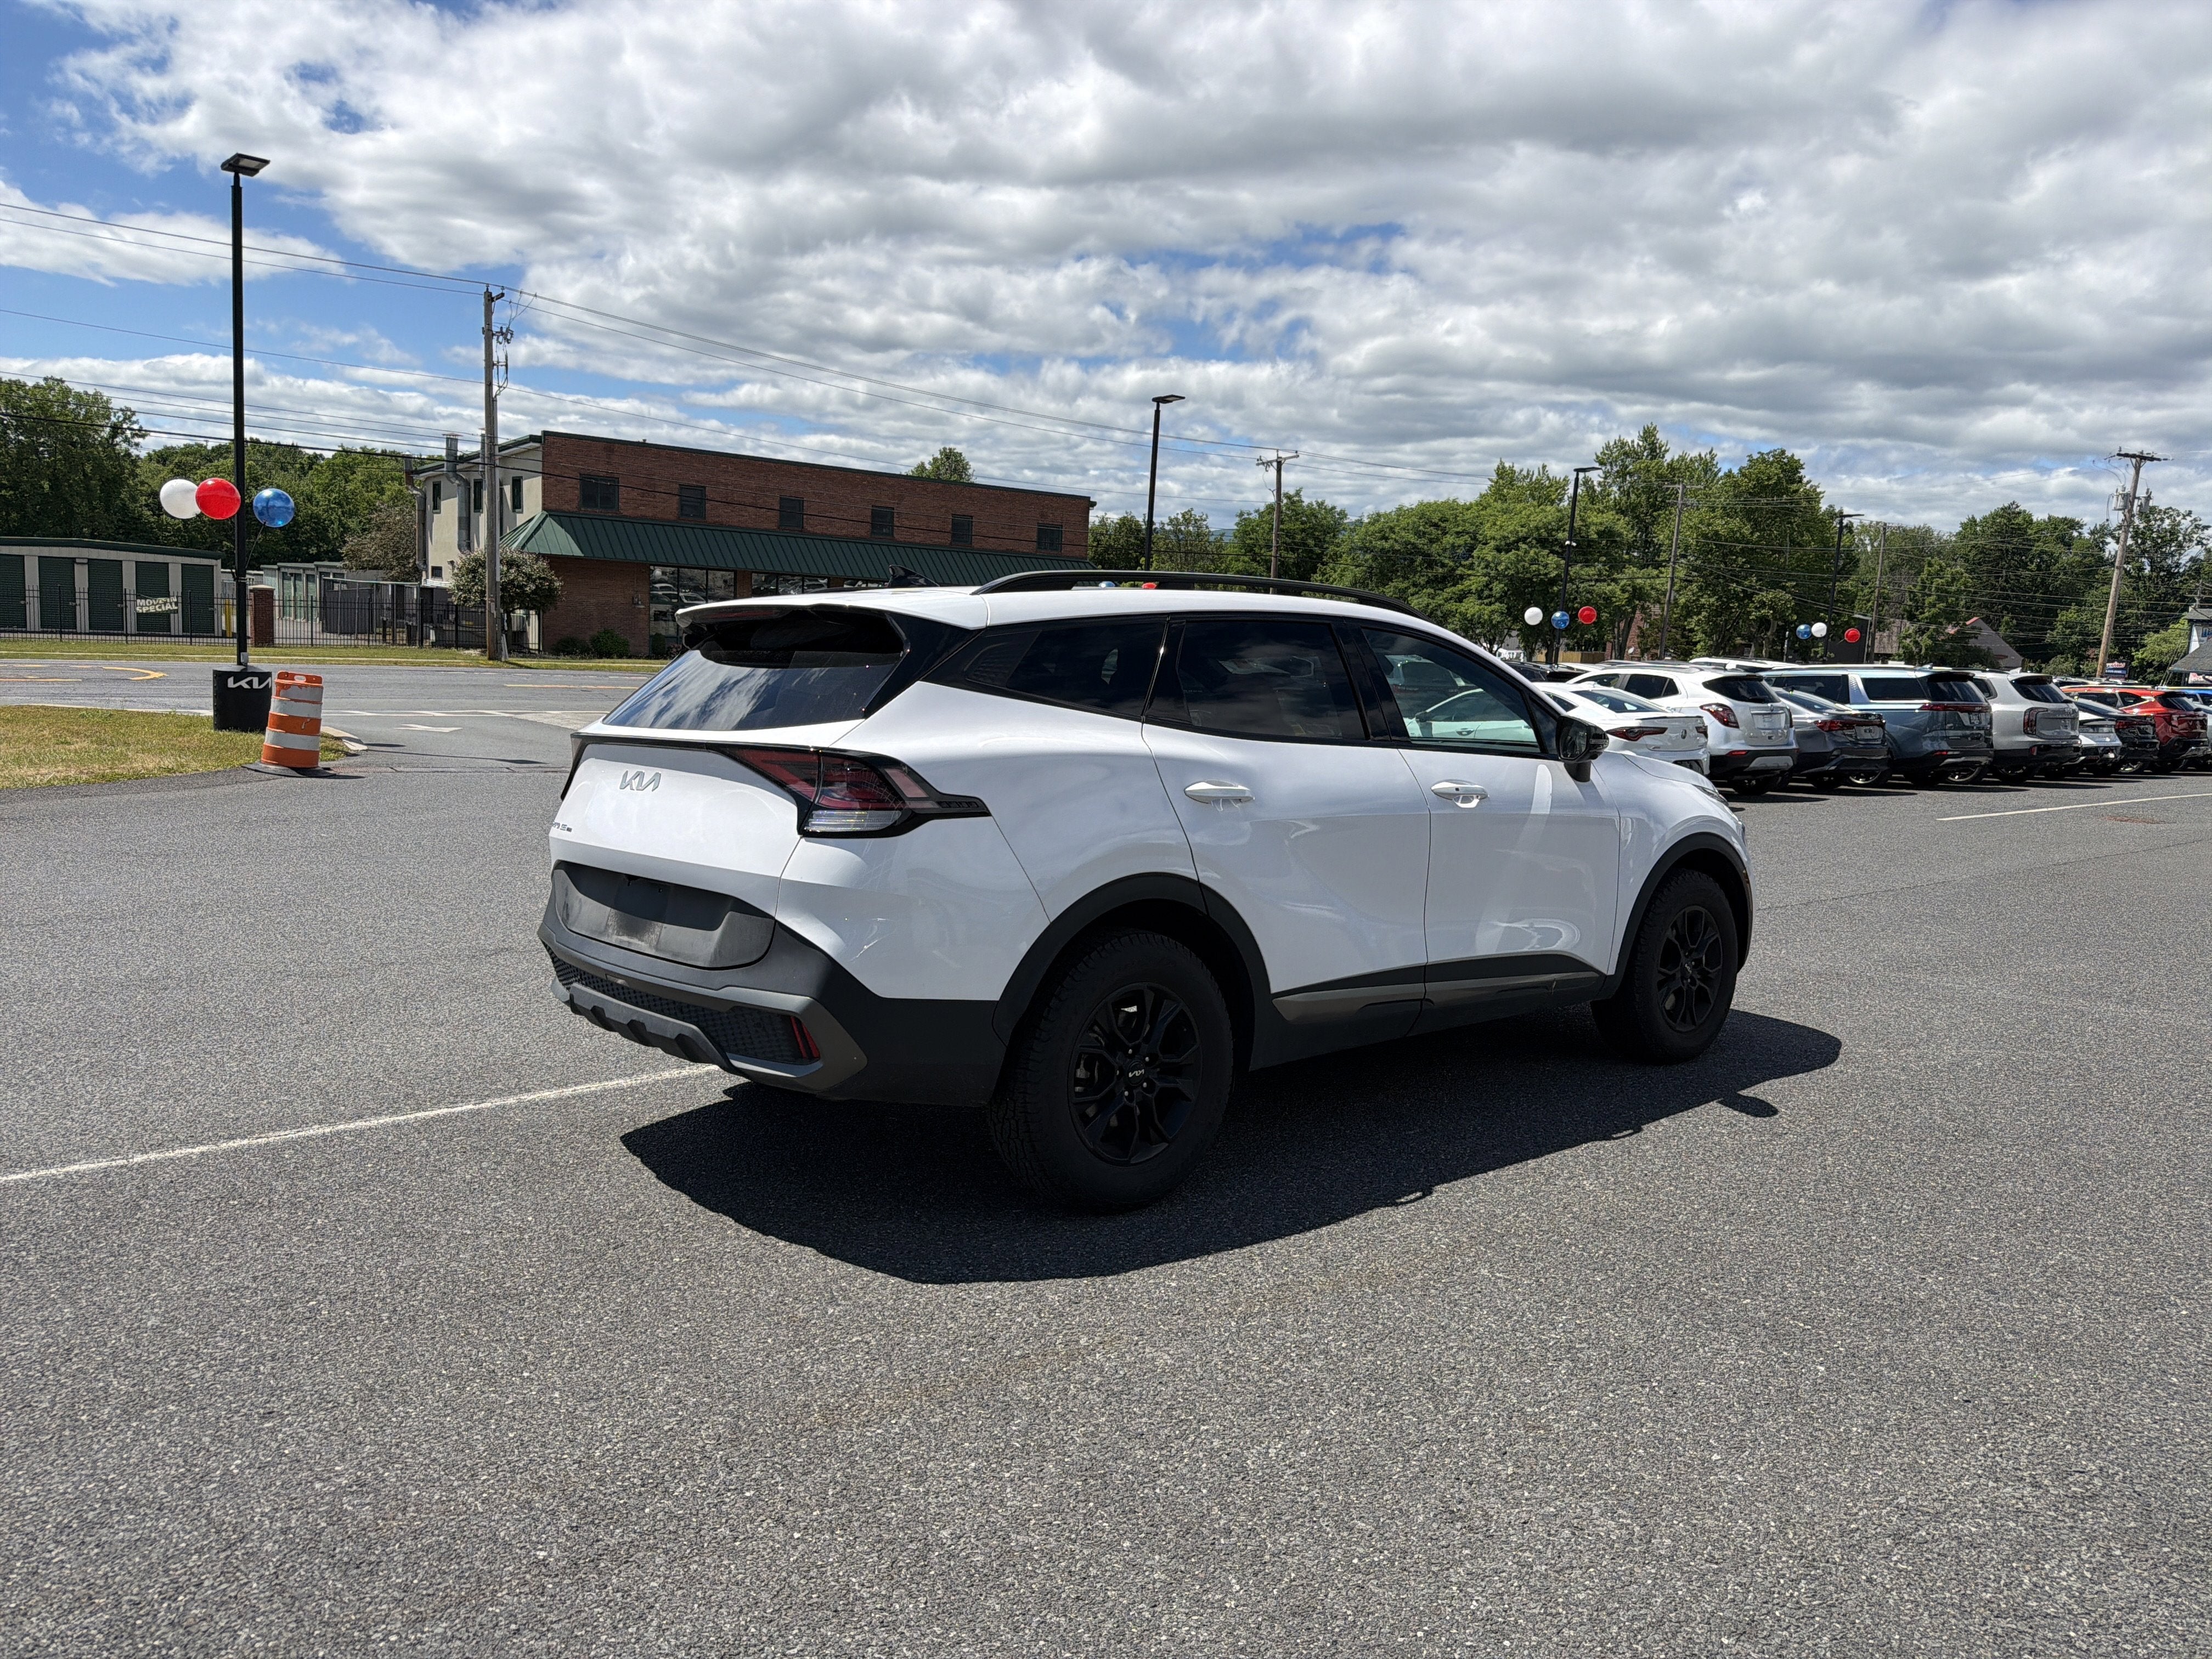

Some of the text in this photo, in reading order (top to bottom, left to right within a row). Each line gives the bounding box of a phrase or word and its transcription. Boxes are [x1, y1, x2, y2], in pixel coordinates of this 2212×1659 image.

[136, 602, 178, 613] SPECIAL
[227, 676, 272, 689] KIA
[619, 770, 662, 792] KIA
[1128, 1069, 1144, 1077] KIA
